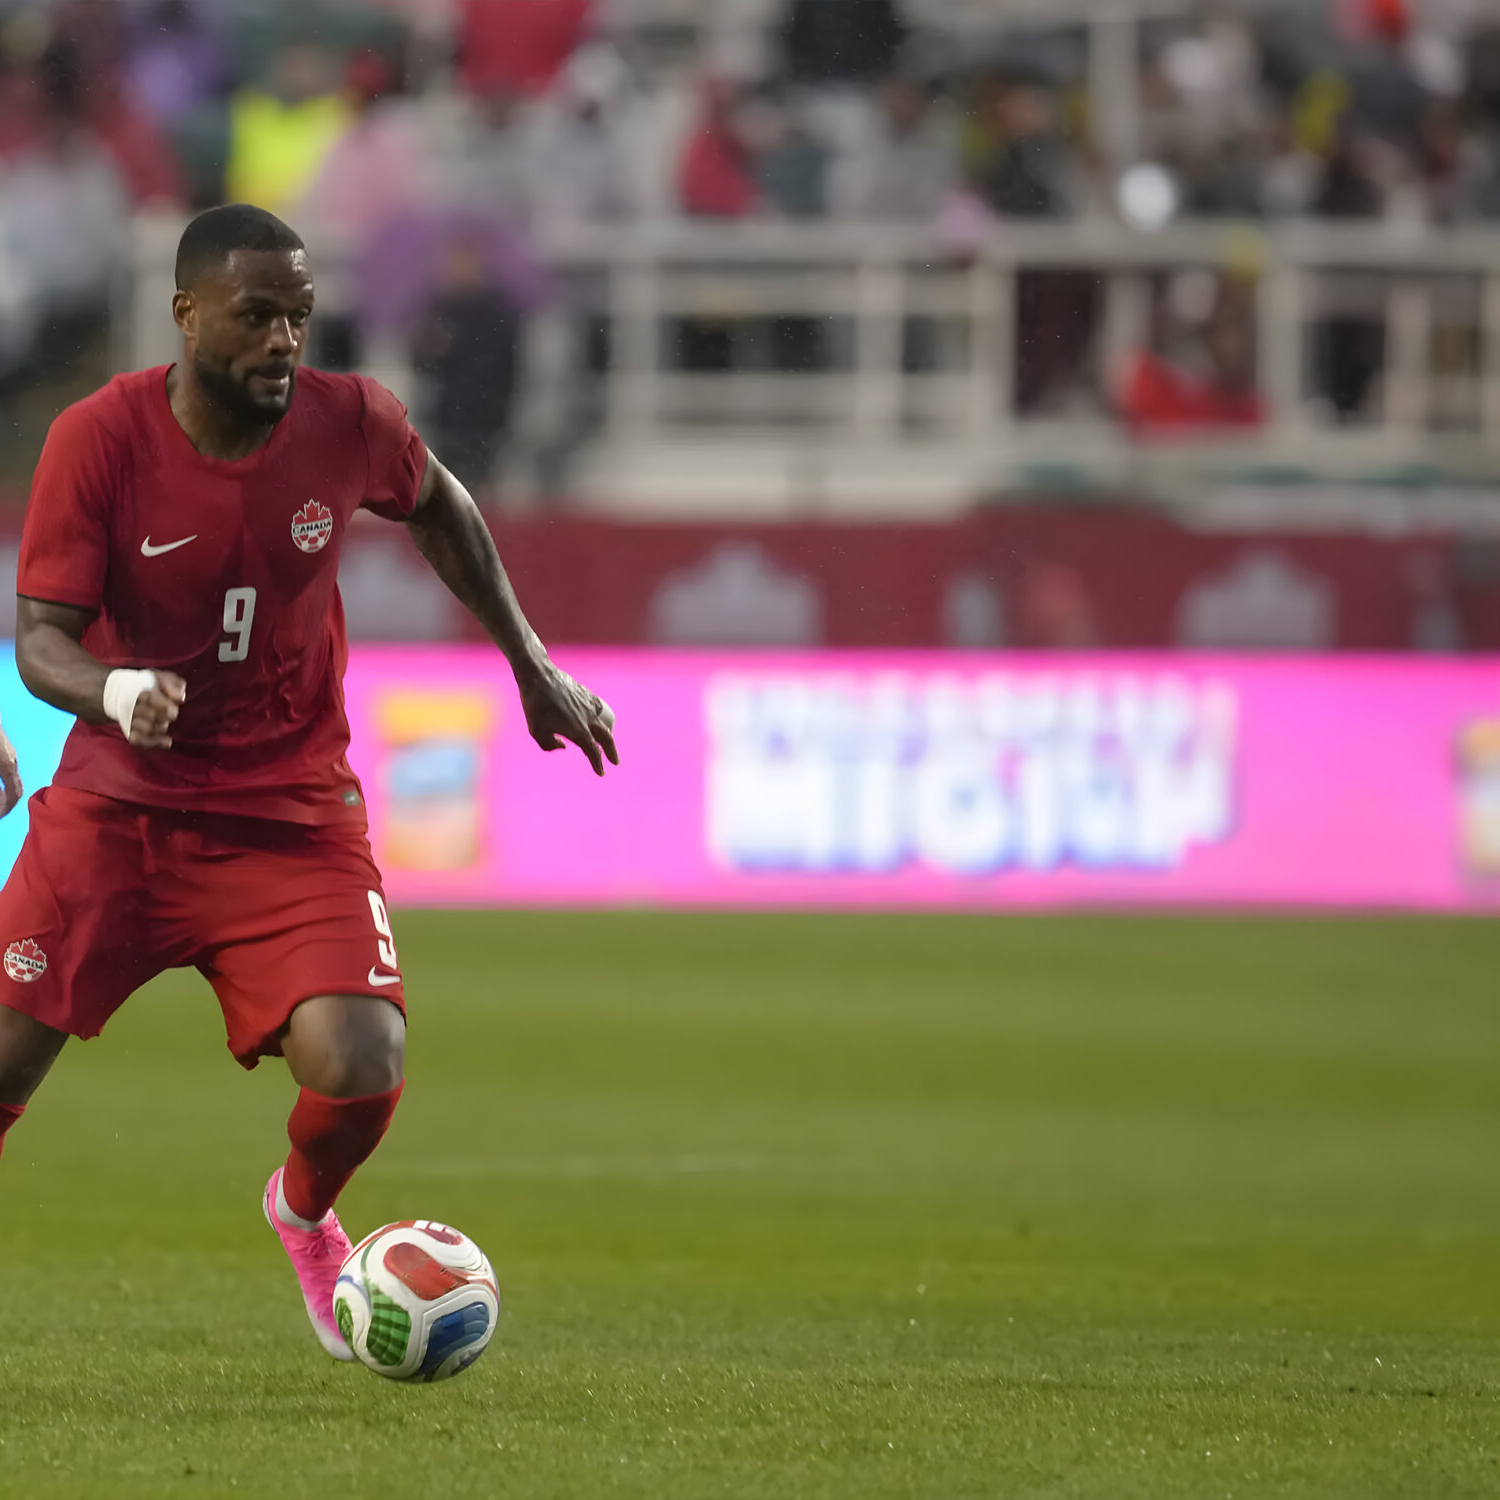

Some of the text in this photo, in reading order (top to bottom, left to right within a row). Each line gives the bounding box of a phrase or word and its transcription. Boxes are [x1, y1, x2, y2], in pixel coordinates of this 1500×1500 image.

[292, 521, 331, 535] CANADA
[218, 587, 257, 662] 9
[367, 890, 397, 970] 9
